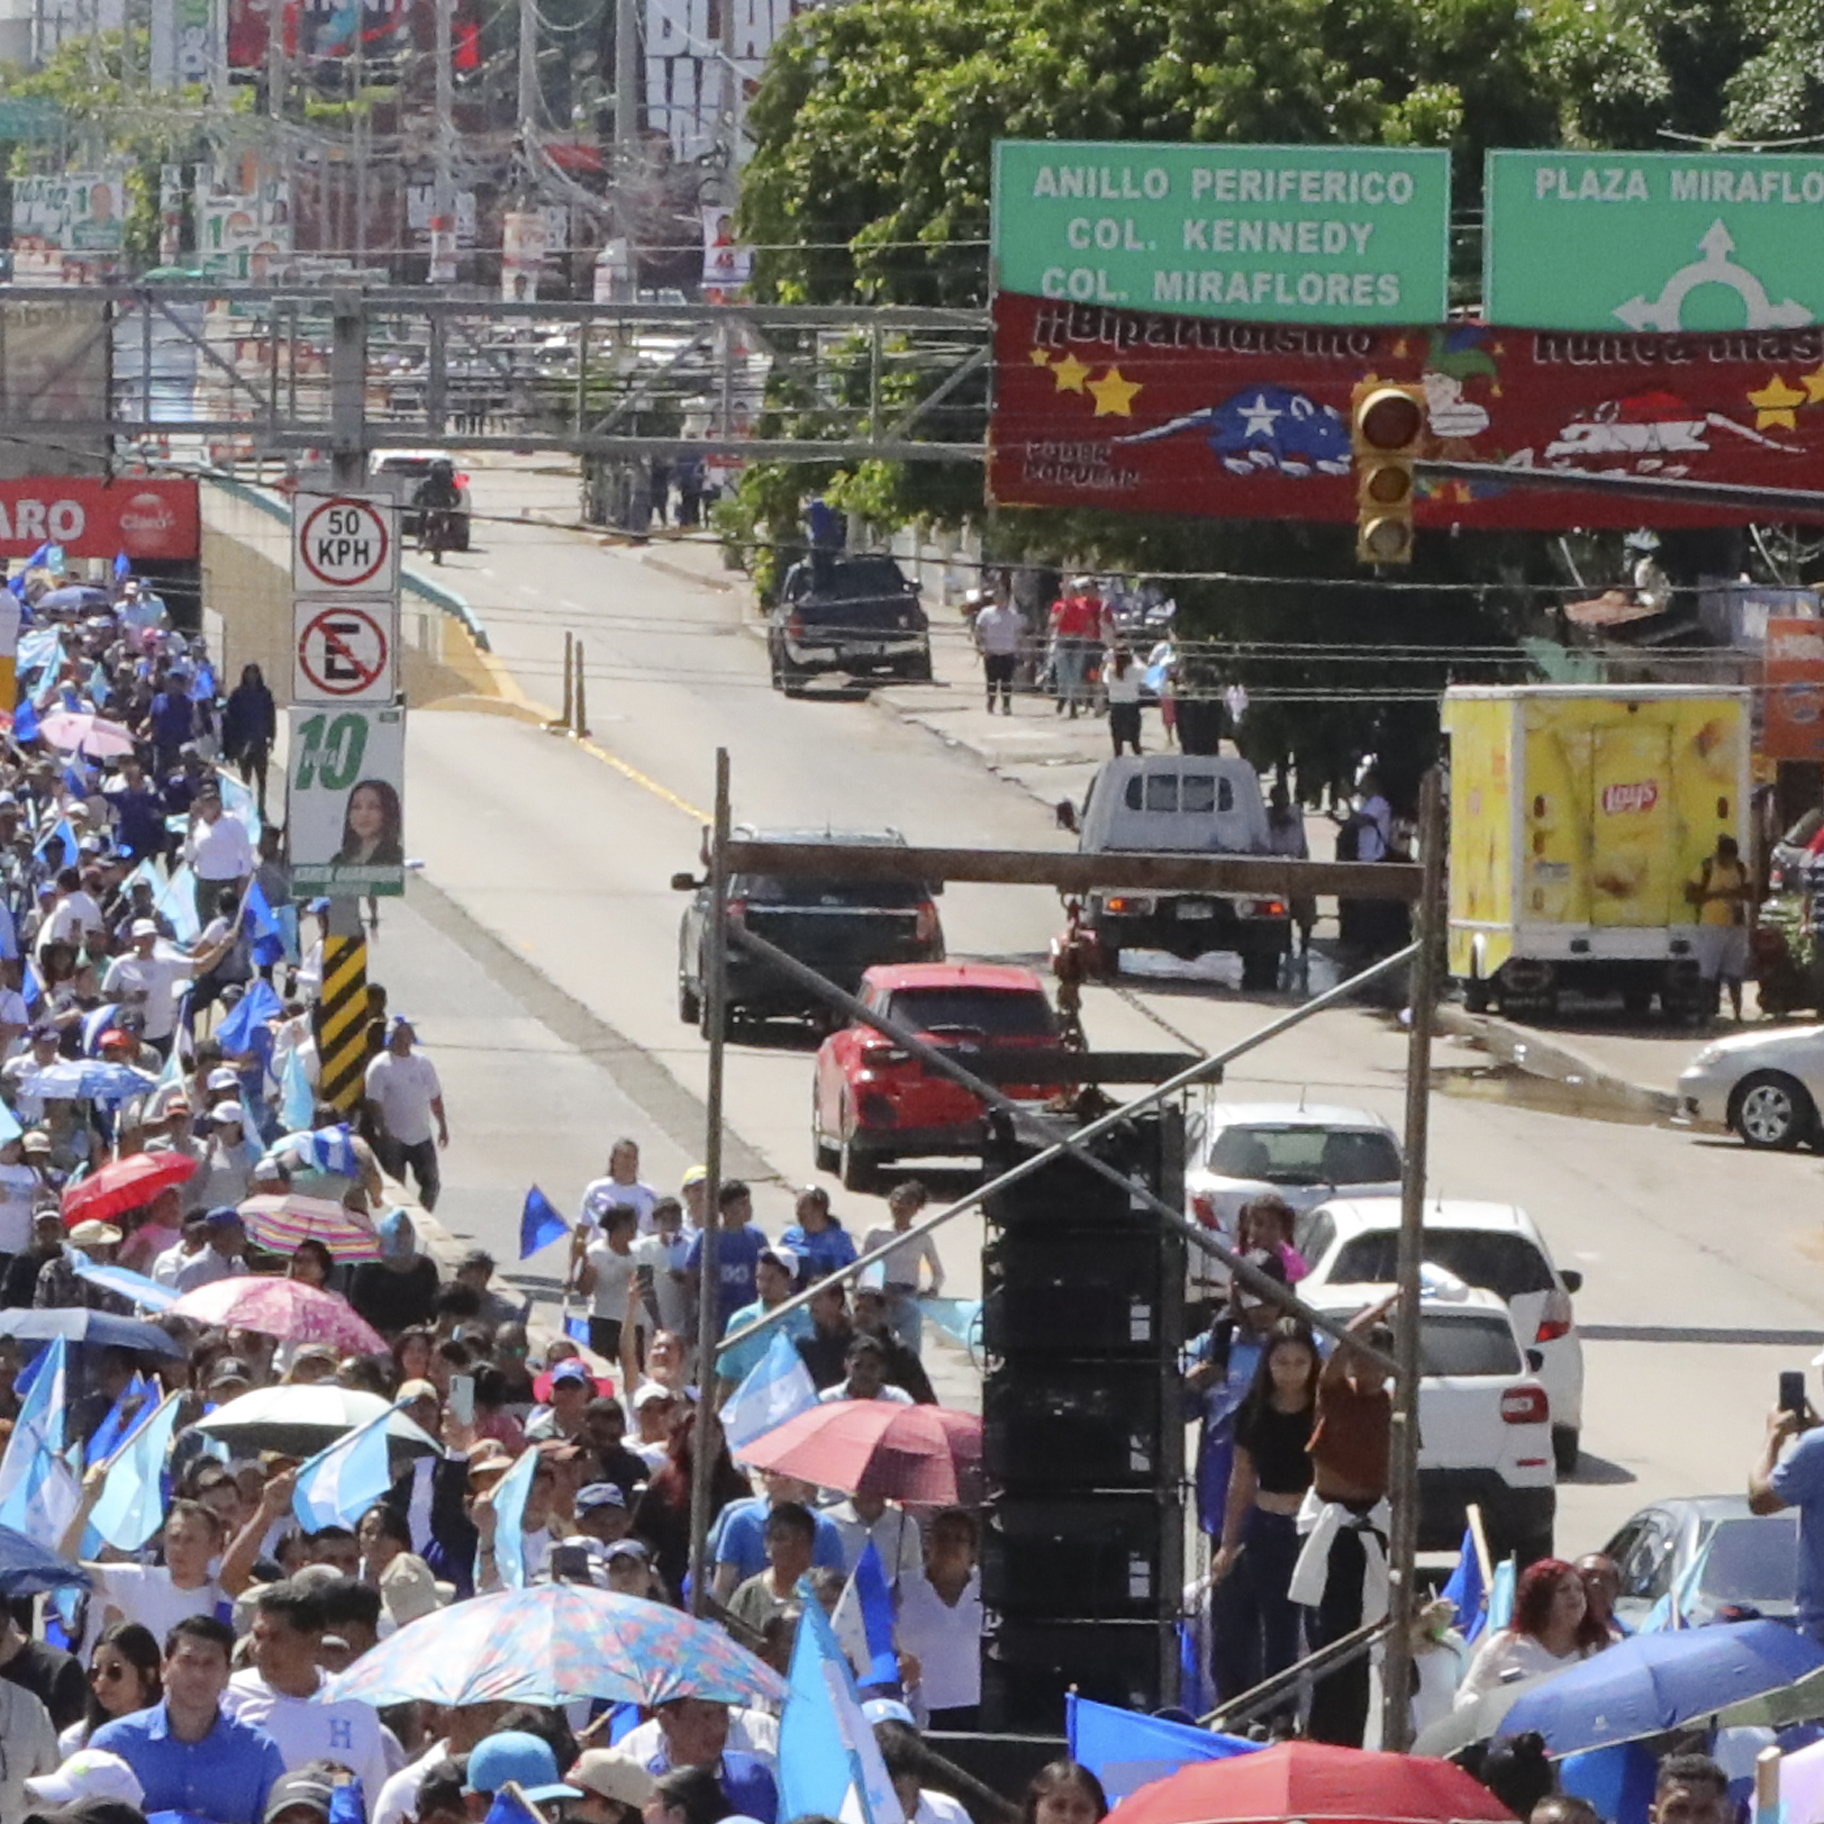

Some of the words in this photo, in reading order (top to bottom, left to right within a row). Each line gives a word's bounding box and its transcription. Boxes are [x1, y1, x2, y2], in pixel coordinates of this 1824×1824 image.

[1034, 167, 1168, 199] ANILLO
[1192, 168, 1413, 204] PERIFERICO
[1536, 168, 1648, 199] PLAZA
[1068, 218, 1154, 250] COL.
[1183, 219, 1374, 255] KENNEDY
[1042, 268, 1127, 300] COL.
[1154, 271, 1401, 304] MIRAFLORES
[328, 510, 360, 535] 50
[318, 540, 369, 568] KPH
[295, 713, 369, 790] 10
[330, 1719, 351, 1748] H
